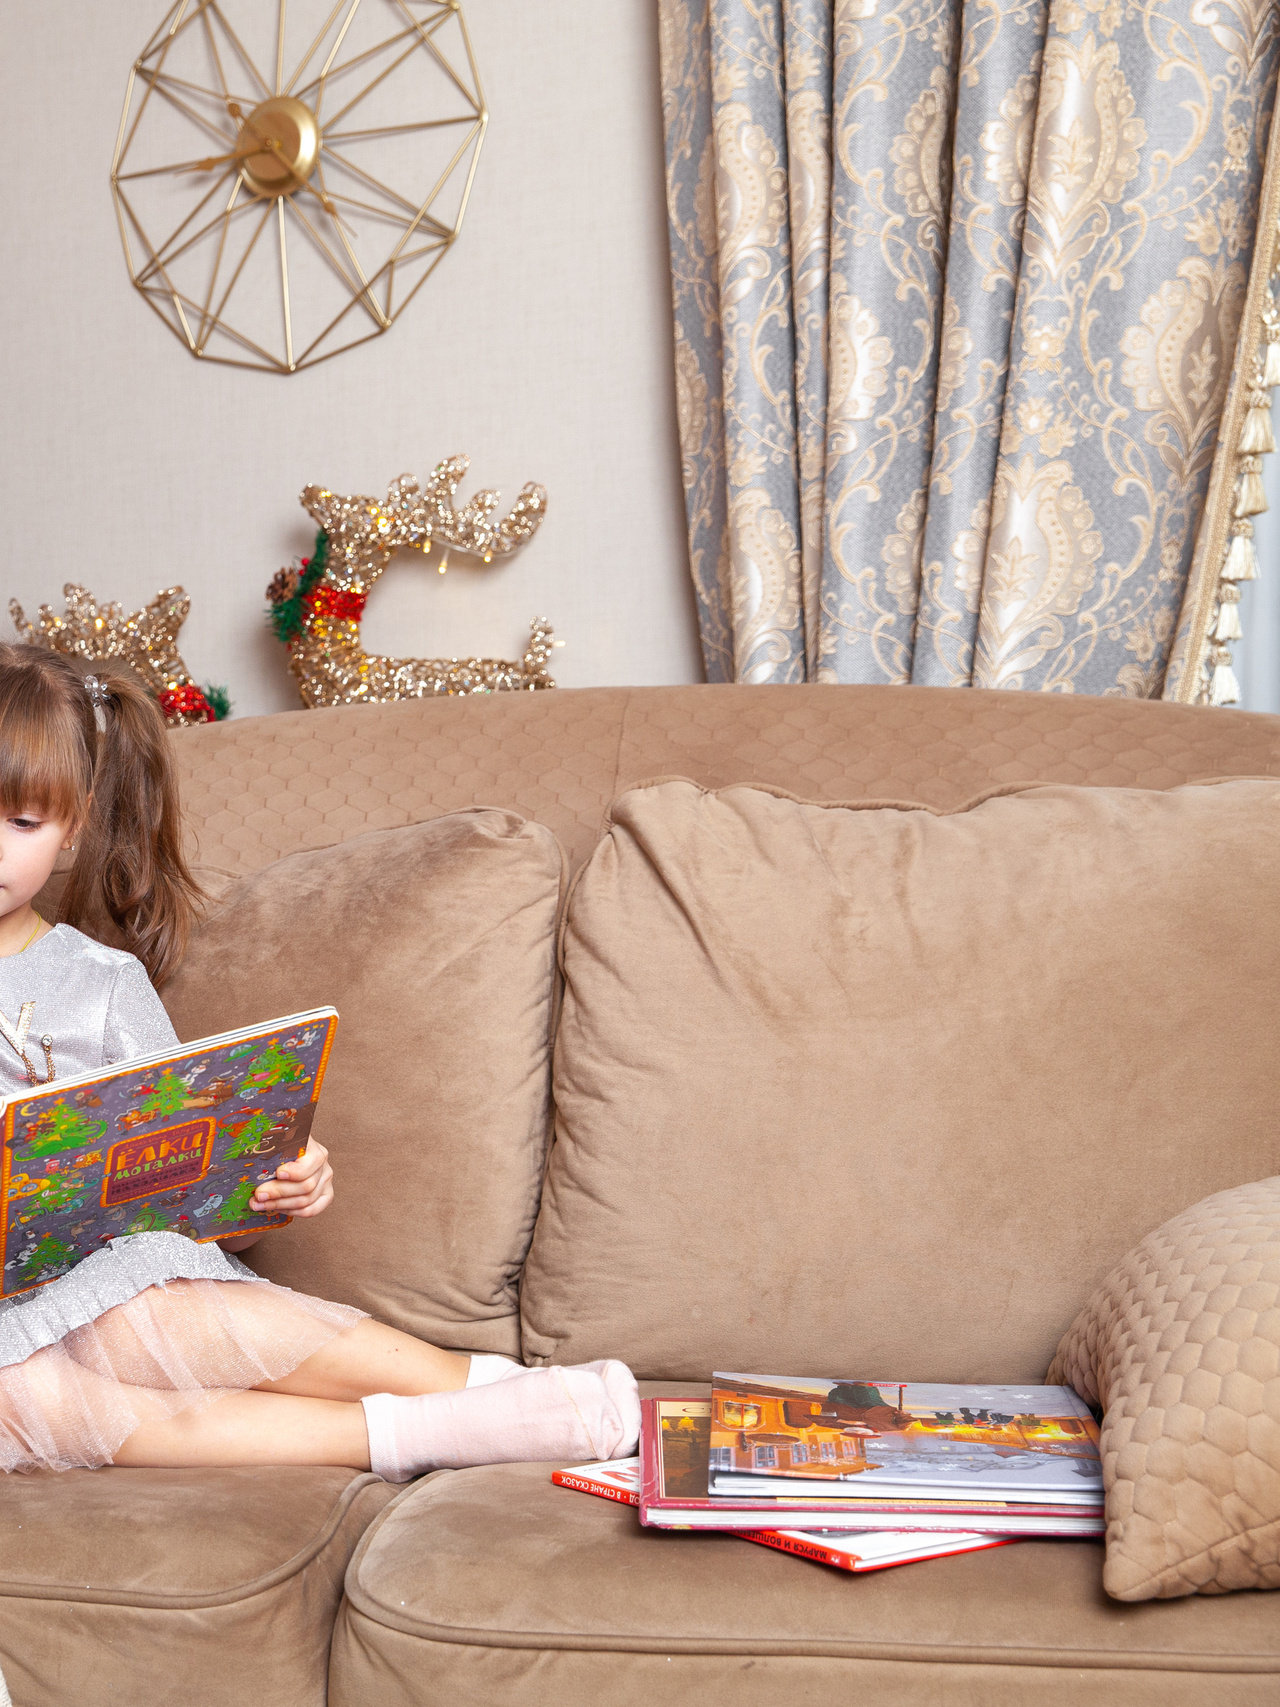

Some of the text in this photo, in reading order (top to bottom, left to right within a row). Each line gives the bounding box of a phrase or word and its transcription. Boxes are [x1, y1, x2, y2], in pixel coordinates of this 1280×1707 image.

[561, 1476, 589, 1490] СКАЗОК
[590, 1483, 615, 1497] СТРАНЕ
[616, 1490, 621, 1499] В
[784, 1540, 790, 1549] И
[793, 1543, 827, 1560] МАРУСЯ
